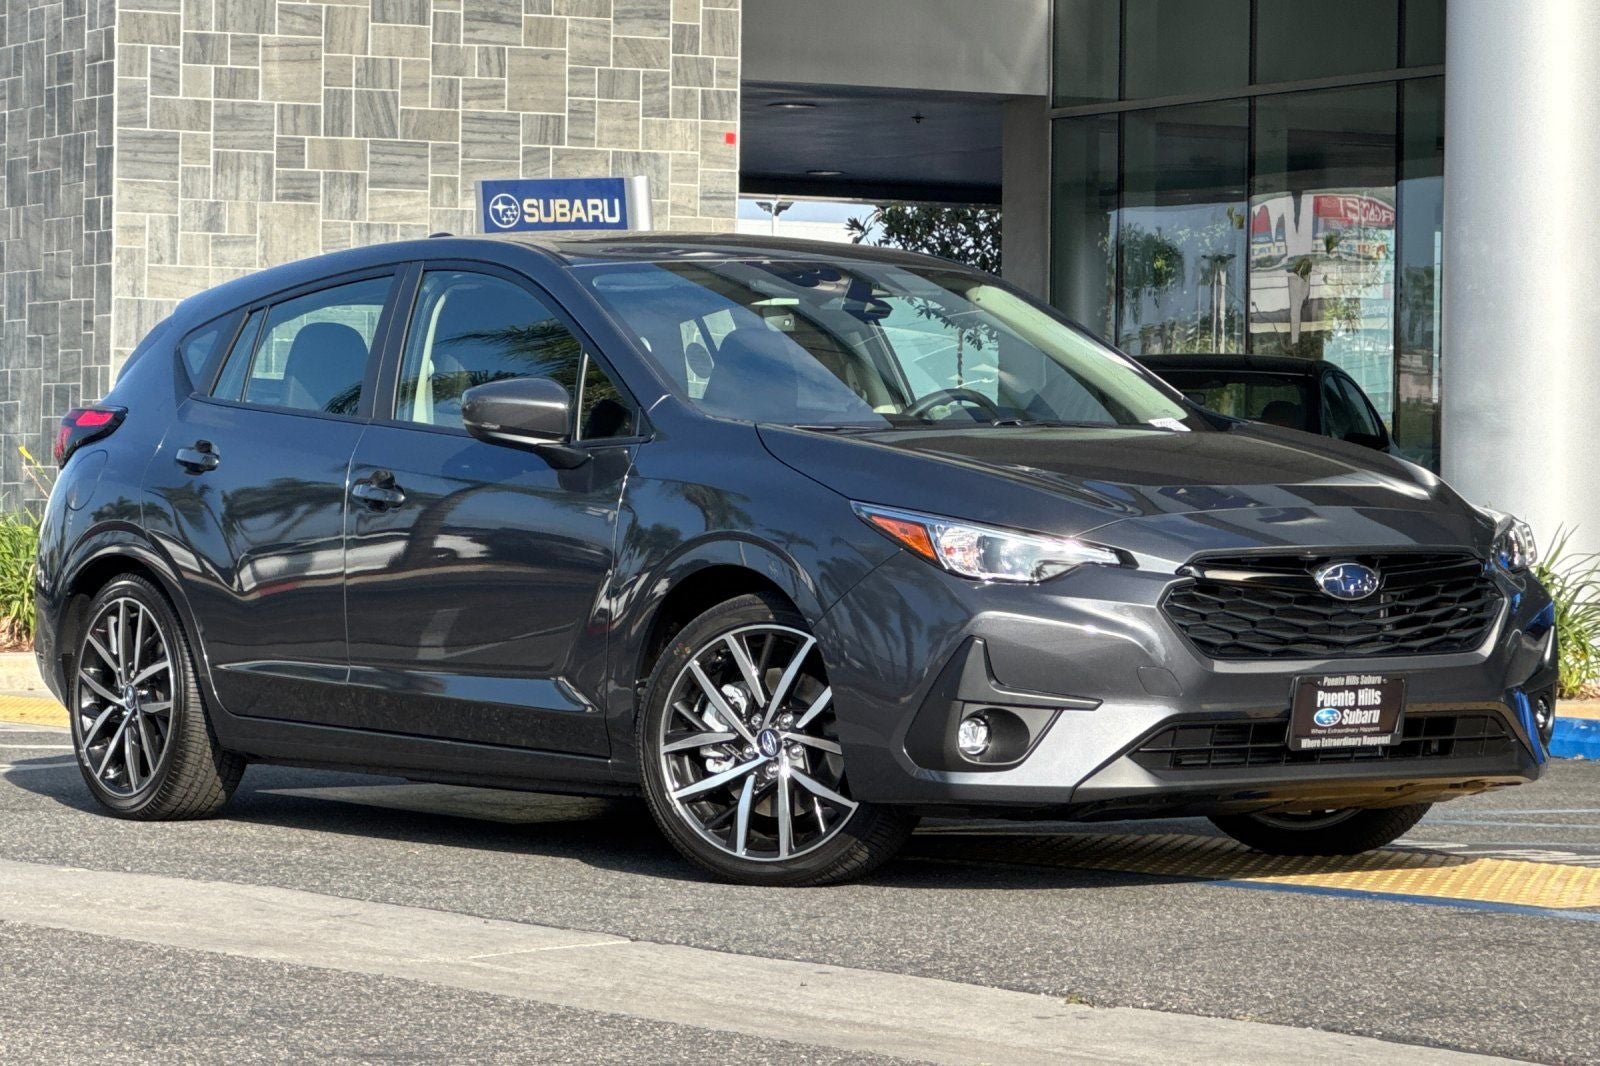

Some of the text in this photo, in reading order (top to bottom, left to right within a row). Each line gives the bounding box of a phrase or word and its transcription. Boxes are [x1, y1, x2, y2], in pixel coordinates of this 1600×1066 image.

[522, 198, 620, 223] SUBARU
[1323, 675, 1382, 686] Puente Hills Subaru
[1317, 688, 1381, 707] Puente Hills
[1342, 709, 1380, 725] Subaru
[1301, 734, 1391, 748] Where Extraordinary Happens!
